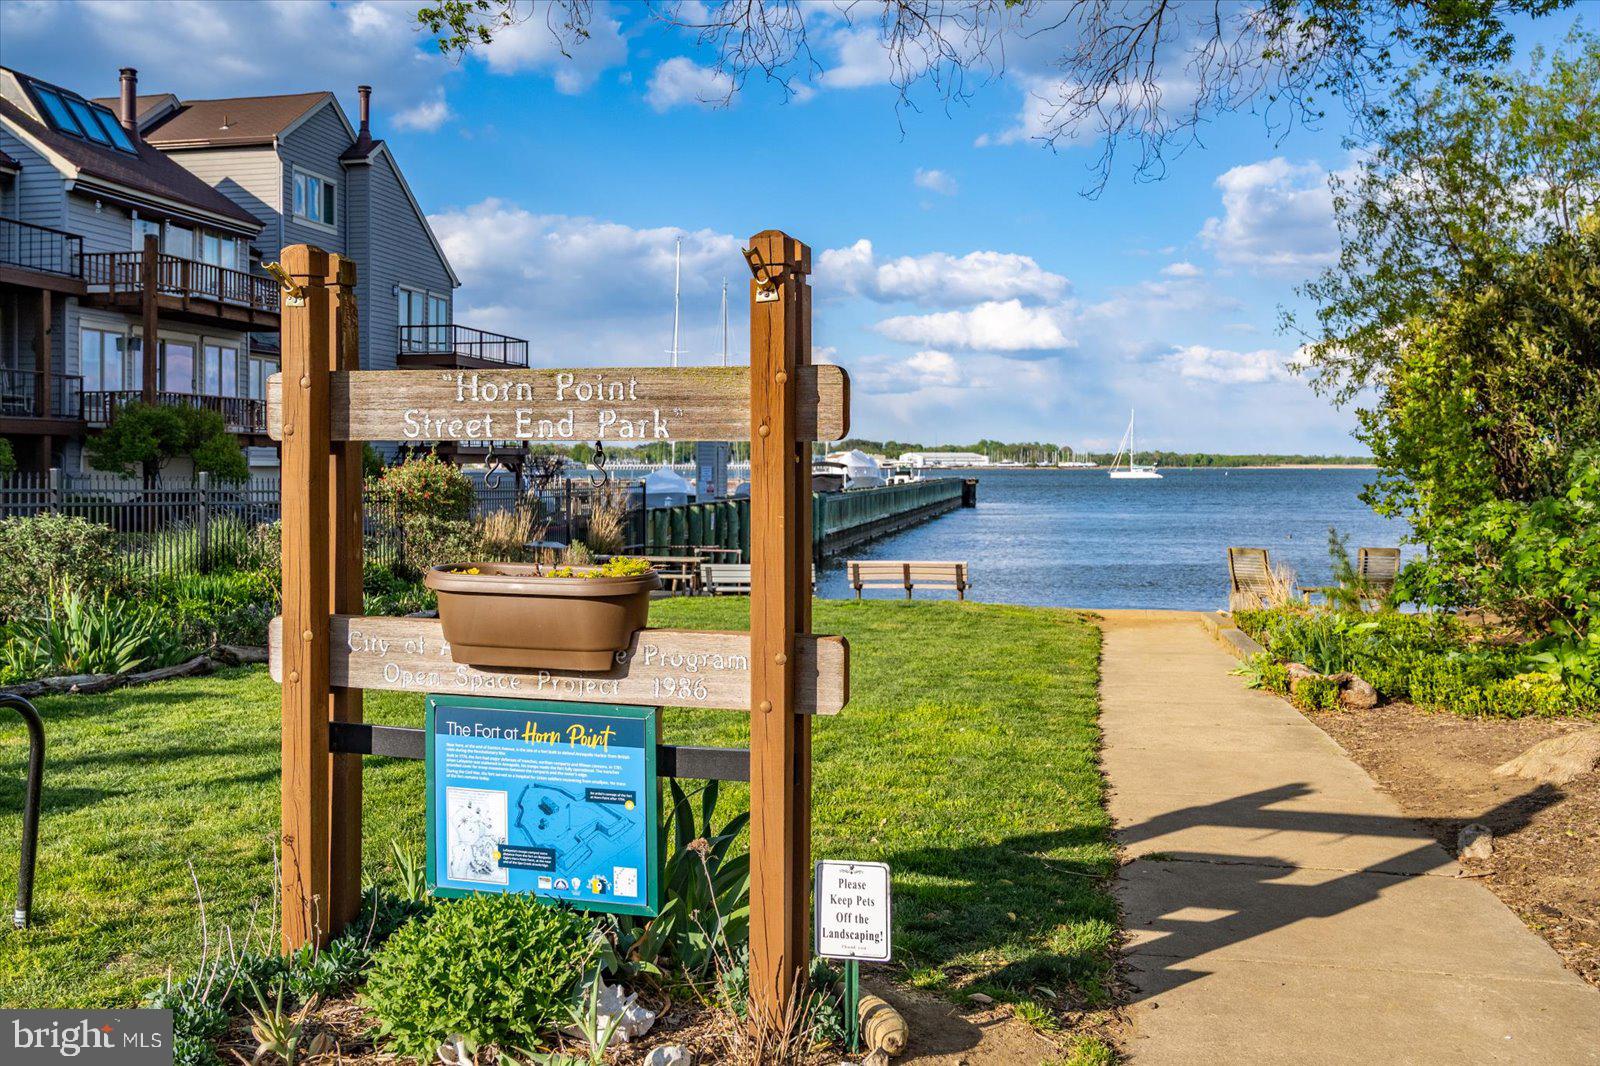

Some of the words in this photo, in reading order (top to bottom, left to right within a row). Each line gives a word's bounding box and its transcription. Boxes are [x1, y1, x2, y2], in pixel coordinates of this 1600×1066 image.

[556, 373, 638, 401] Point
[403, 408, 493, 438] Street
[515, 408, 575, 438] End
[348, 631, 391, 657] City
[405, 635, 425, 656] of
[643, 644, 748, 673] Program
[383, 662, 441, 688] Open
[455, 663, 521, 692] Space
[536, 670, 621, 697] Project
[653, 677, 708, 701] 1986
[446, 721, 471, 737] The
[474, 723, 501, 739] Fort
[504, 728, 519, 741] at
[521, 720, 561, 747] Horn
[566, 723, 616, 753] Point
[838, 878, 867, 890] Please
[830, 894, 853, 908] Keep
[856, 895, 876, 907] Pets
[836, 911, 852, 924] Off
[854, 913, 870, 925] the
[822, 927, 884, 944] Landscaping!
